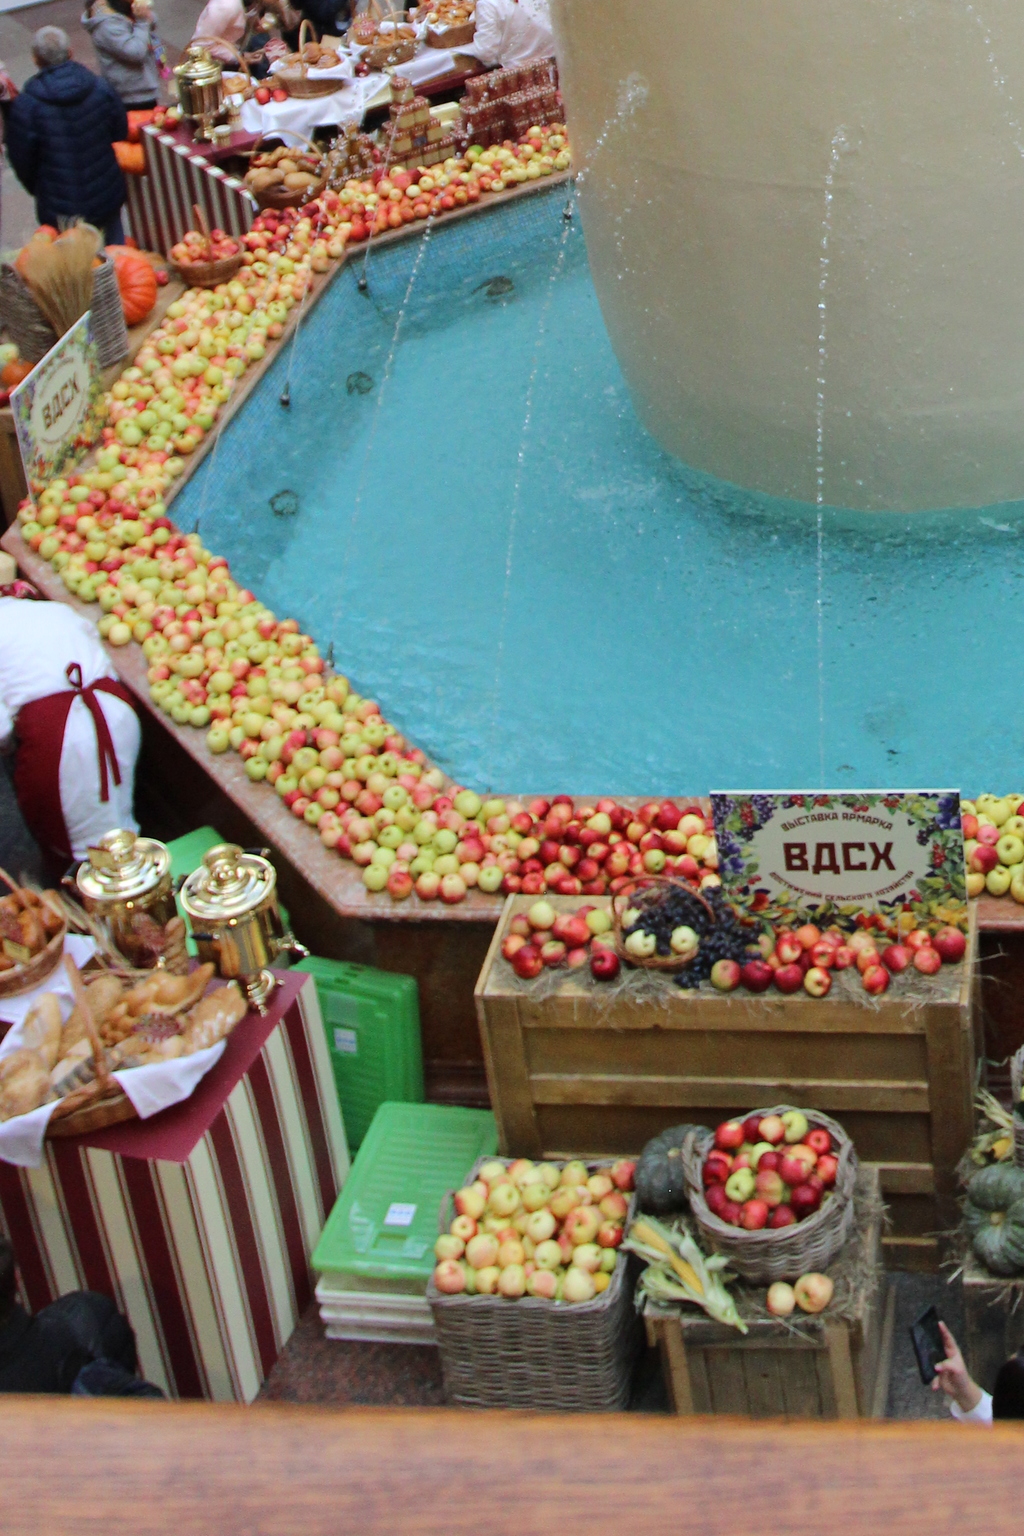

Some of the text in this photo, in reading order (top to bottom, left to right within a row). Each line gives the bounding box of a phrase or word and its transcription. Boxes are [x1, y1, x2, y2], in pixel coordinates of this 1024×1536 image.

[780, 812, 894, 832] ВЫСТАВКА ЯРМАРКА
[783, 841, 896, 875] ВДСХ
